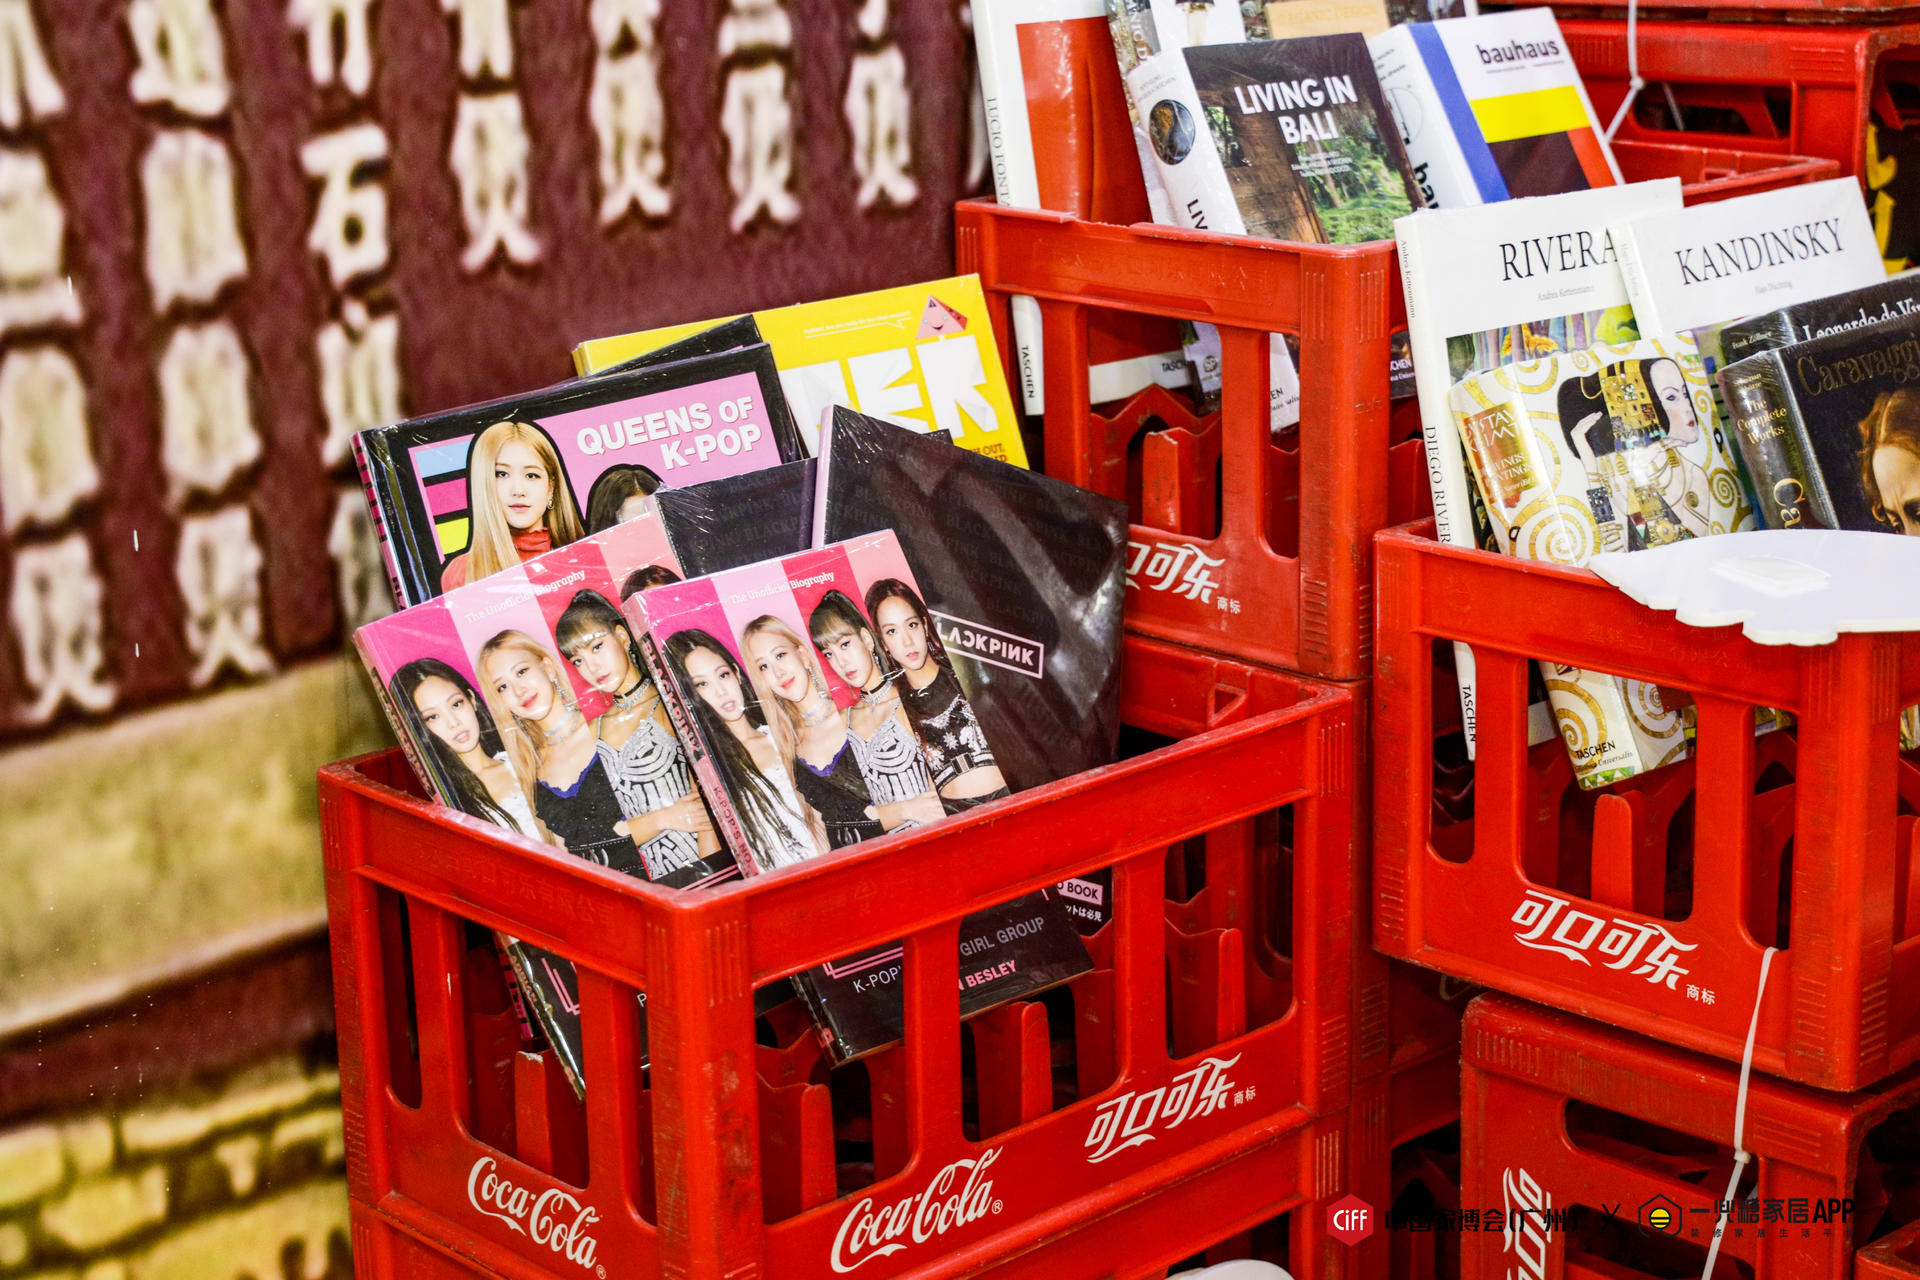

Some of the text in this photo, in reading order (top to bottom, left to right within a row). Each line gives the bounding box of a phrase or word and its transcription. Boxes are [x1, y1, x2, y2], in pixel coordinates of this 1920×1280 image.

[1476, 40, 1560, 64] bauhaus
[1234, 75, 1358, 114] LIVING IN
[986, 97, 1002, 149] LUCIO
[1278, 111, 1339, 144] BALI
[1499, 226, 1619, 281] RIVERA
[1674, 218, 1844, 286] KANDINSKY
[1021, 345, 1035, 399] TASCHEN
[1737, 407, 1787, 432] Complete
[1747, 399, 1768, 413] The
[577, 396, 753, 456] QUEENS OF
[1748, 426, 1785, 445] Works
[659, 423, 762, 471] K-POP
[1425, 426, 1443, 484] DIEGO
[535, 570, 586, 597] Biography
[790, 571, 834, 589] Biography
[1575, 740, 1616, 760] TASCHEN
[1067, 881, 1098, 900] BOOK
[959, 917, 1045, 957] GIRL GROUP
[1511, 889, 1716, 1006] 可口可乐 商标
[965, 959, 1017, 988] BESLEY
[1084, 1052, 1256, 1163] 可口可乐 商标
